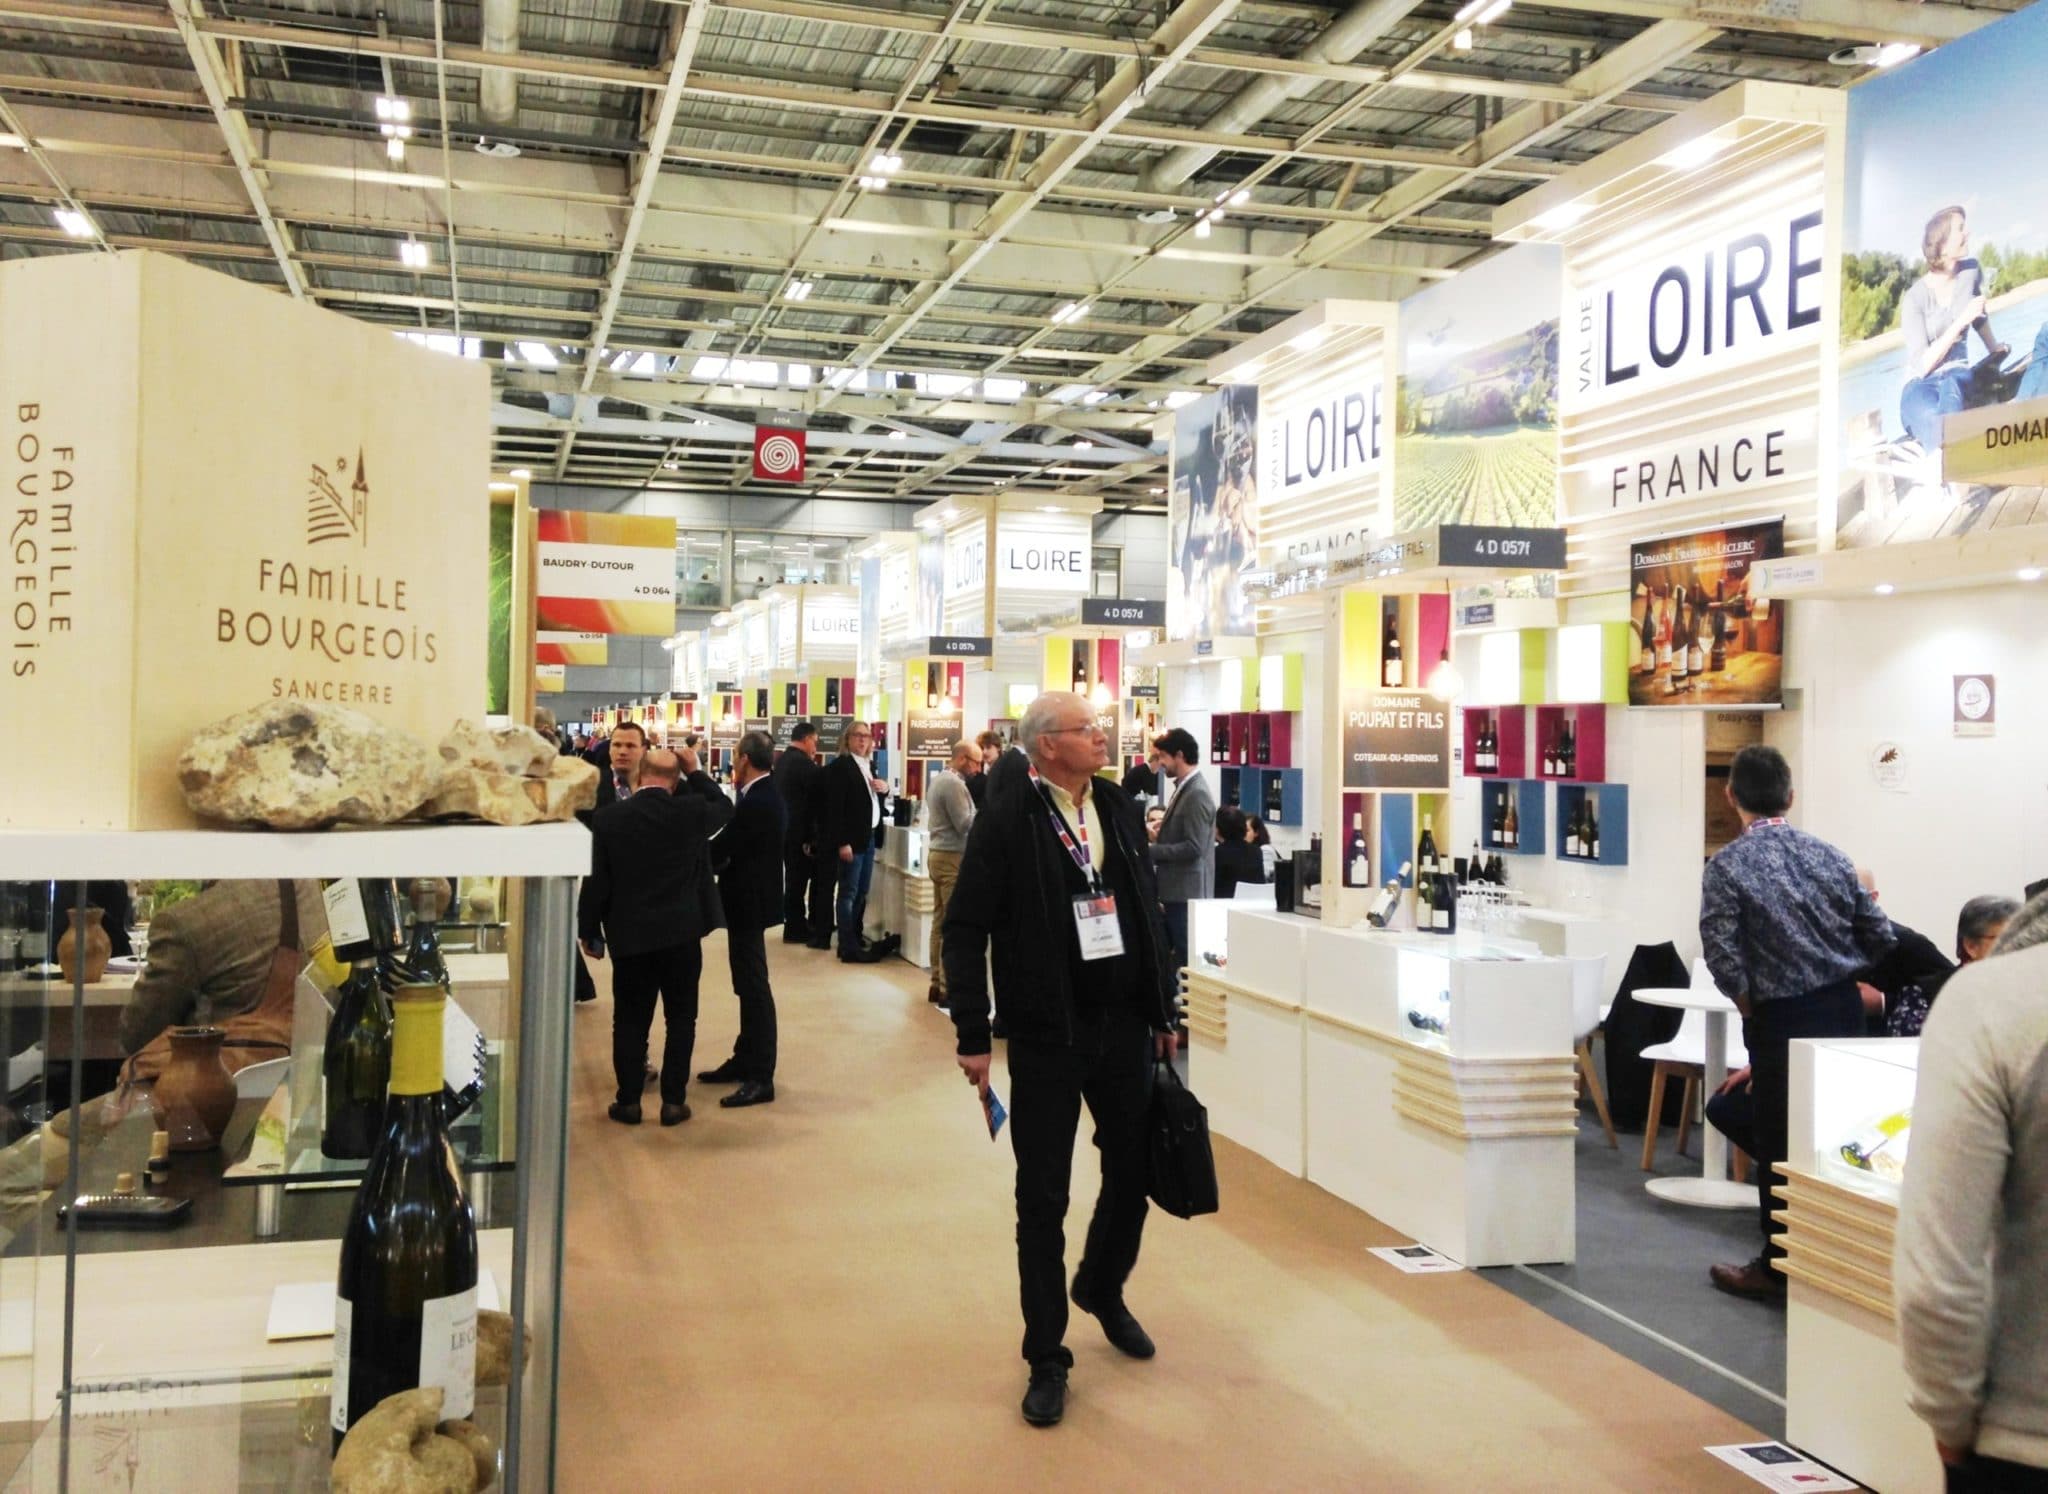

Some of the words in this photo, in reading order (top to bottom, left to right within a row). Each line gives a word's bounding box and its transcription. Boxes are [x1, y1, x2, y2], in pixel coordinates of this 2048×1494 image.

[1604, 208, 1824, 387] LOIRE
[1580, 298, 1593, 333] DE
[1579, 340, 1593, 393] VAL
[1284, 382, 1382, 488] LOIRE
[1612, 429, 1786, 508] FRANCE
[1474, 539, 1485, 554] 4
[1487, 540, 1499, 555] D
[1501, 540, 1531, 556] 057f
[543, 558, 634, 571] BAUDRY-DUTOUR
[1010, 548, 1082, 573] LOIRE
[1634, 550, 1674, 567] DOMAINE
[642, 586, 651, 594] D
[652, 586, 670, 595] 064
[1103, 607, 1111, 617] 4
[1112, 607, 1120, 618] D
[811, 617, 859, 633] LOIRE
[272, 677, 393, 705] SANCERRE
[1374, 696, 1422, 709] DOMAINE
[1349, 711, 1397, 728] POUPAT
[1399, 711, 1415, 728] ET
[1417, 712, 1444, 729] FILS
